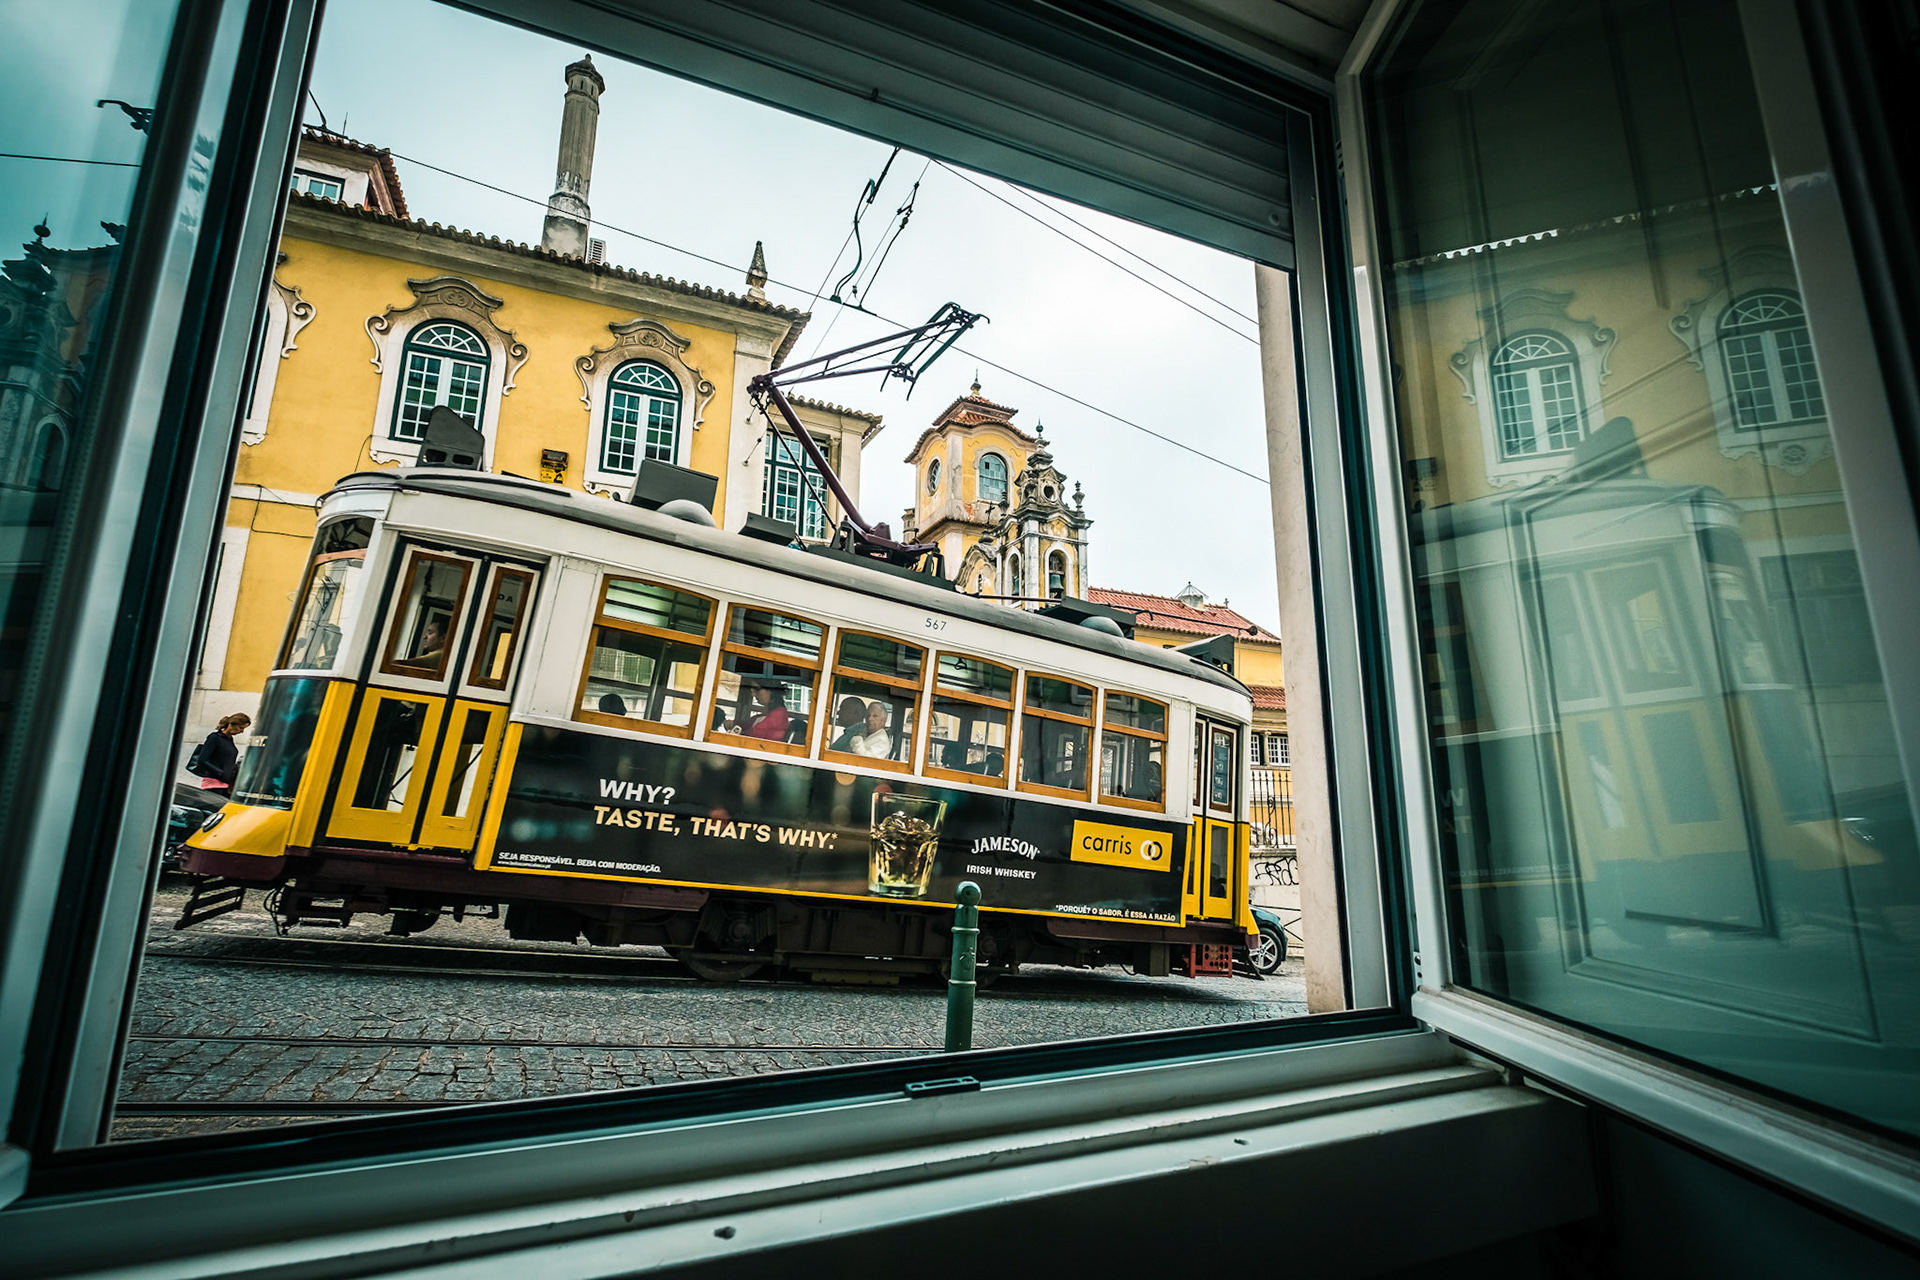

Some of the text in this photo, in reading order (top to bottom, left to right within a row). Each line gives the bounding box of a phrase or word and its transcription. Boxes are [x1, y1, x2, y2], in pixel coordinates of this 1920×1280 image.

[925, 617, 947, 630] 567
[599, 778, 676, 806] WHY?
[593, 805, 680, 837] TASTE,
[690, 816, 771, 843] THAT'S
[1082, 834, 1133, 856] carris
[498, 852, 518, 861] SEJA
[576, 859, 597, 868] BEBA
[597, 860, 615, 869] COM
[966, 864, 1037, 880] IRISH WHISKEY
[1098, 908, 1123, 918] SABOR,
[1124, 909, 1130, 918] É
[1130, 911, 1147, 919] ESSA
[1154, 912, 1176, 921] RAZÃO
